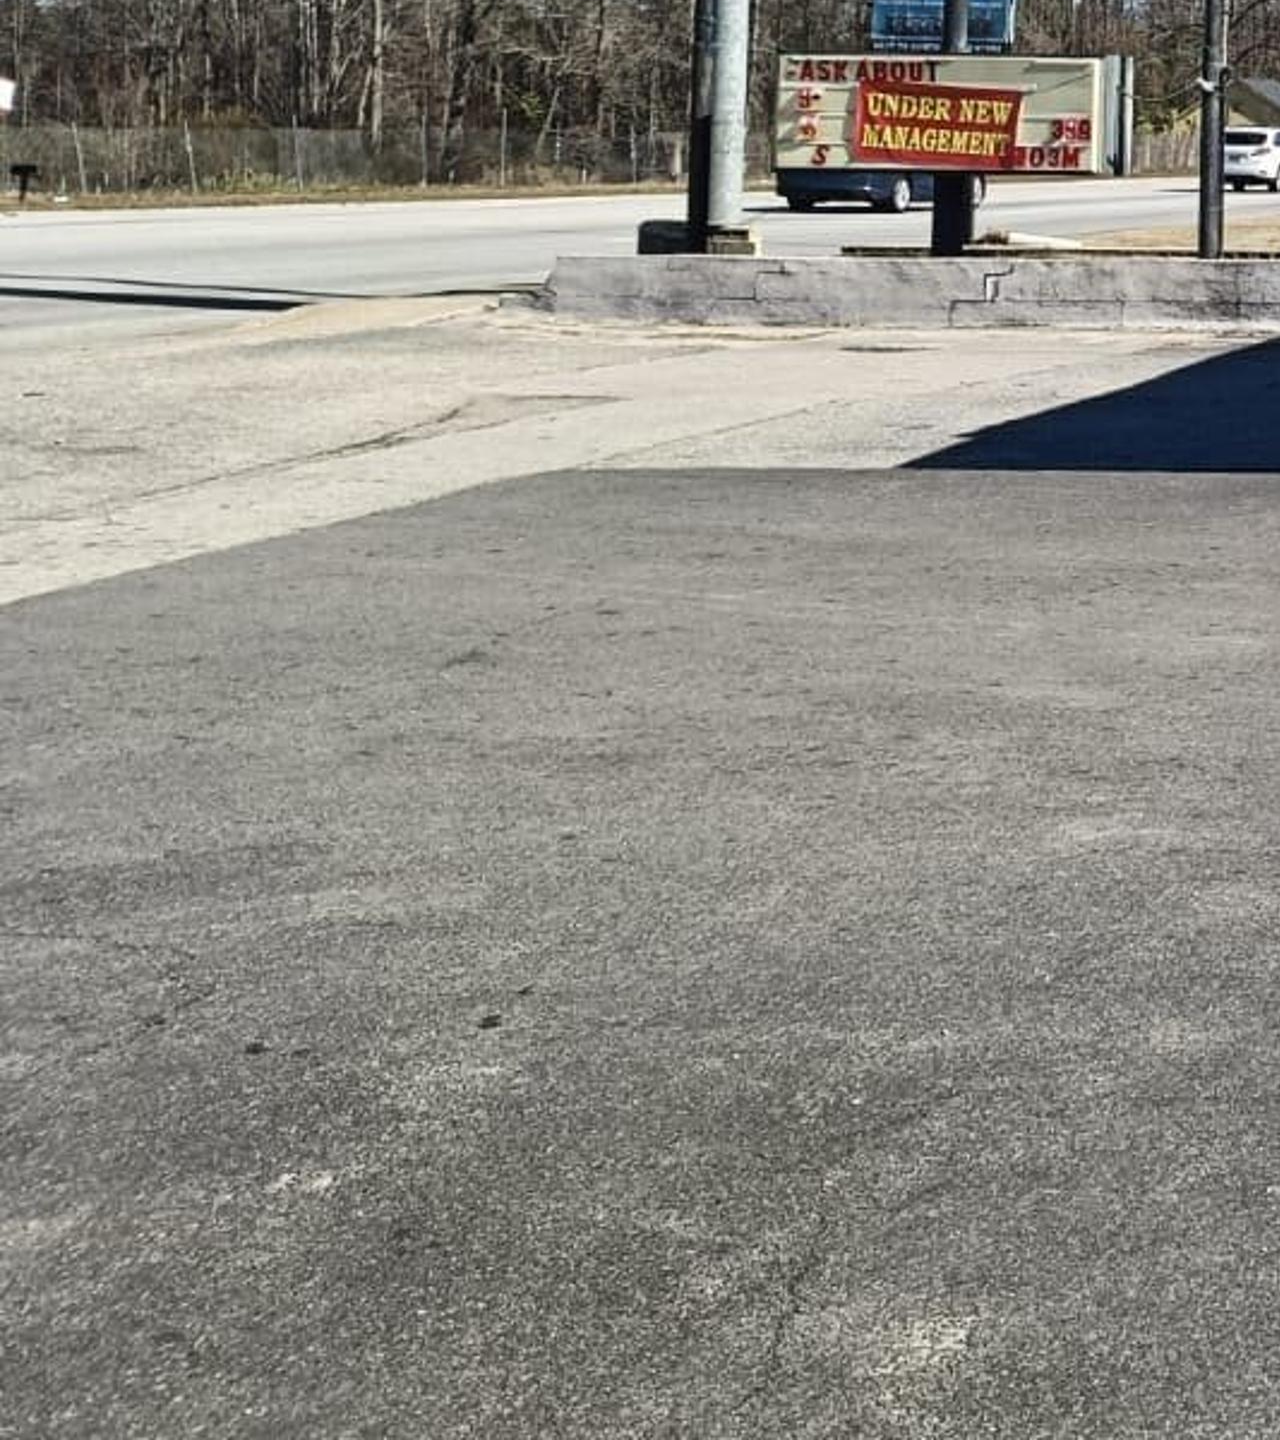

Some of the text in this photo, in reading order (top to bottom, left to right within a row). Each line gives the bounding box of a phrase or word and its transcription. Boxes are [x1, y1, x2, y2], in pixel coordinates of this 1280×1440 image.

[799, 58, 940, 82] ASK ABOUT
[867, 91, 1013, 126] UNDER NEW
[861, 123, 1011, 157] MANAGEMENT
